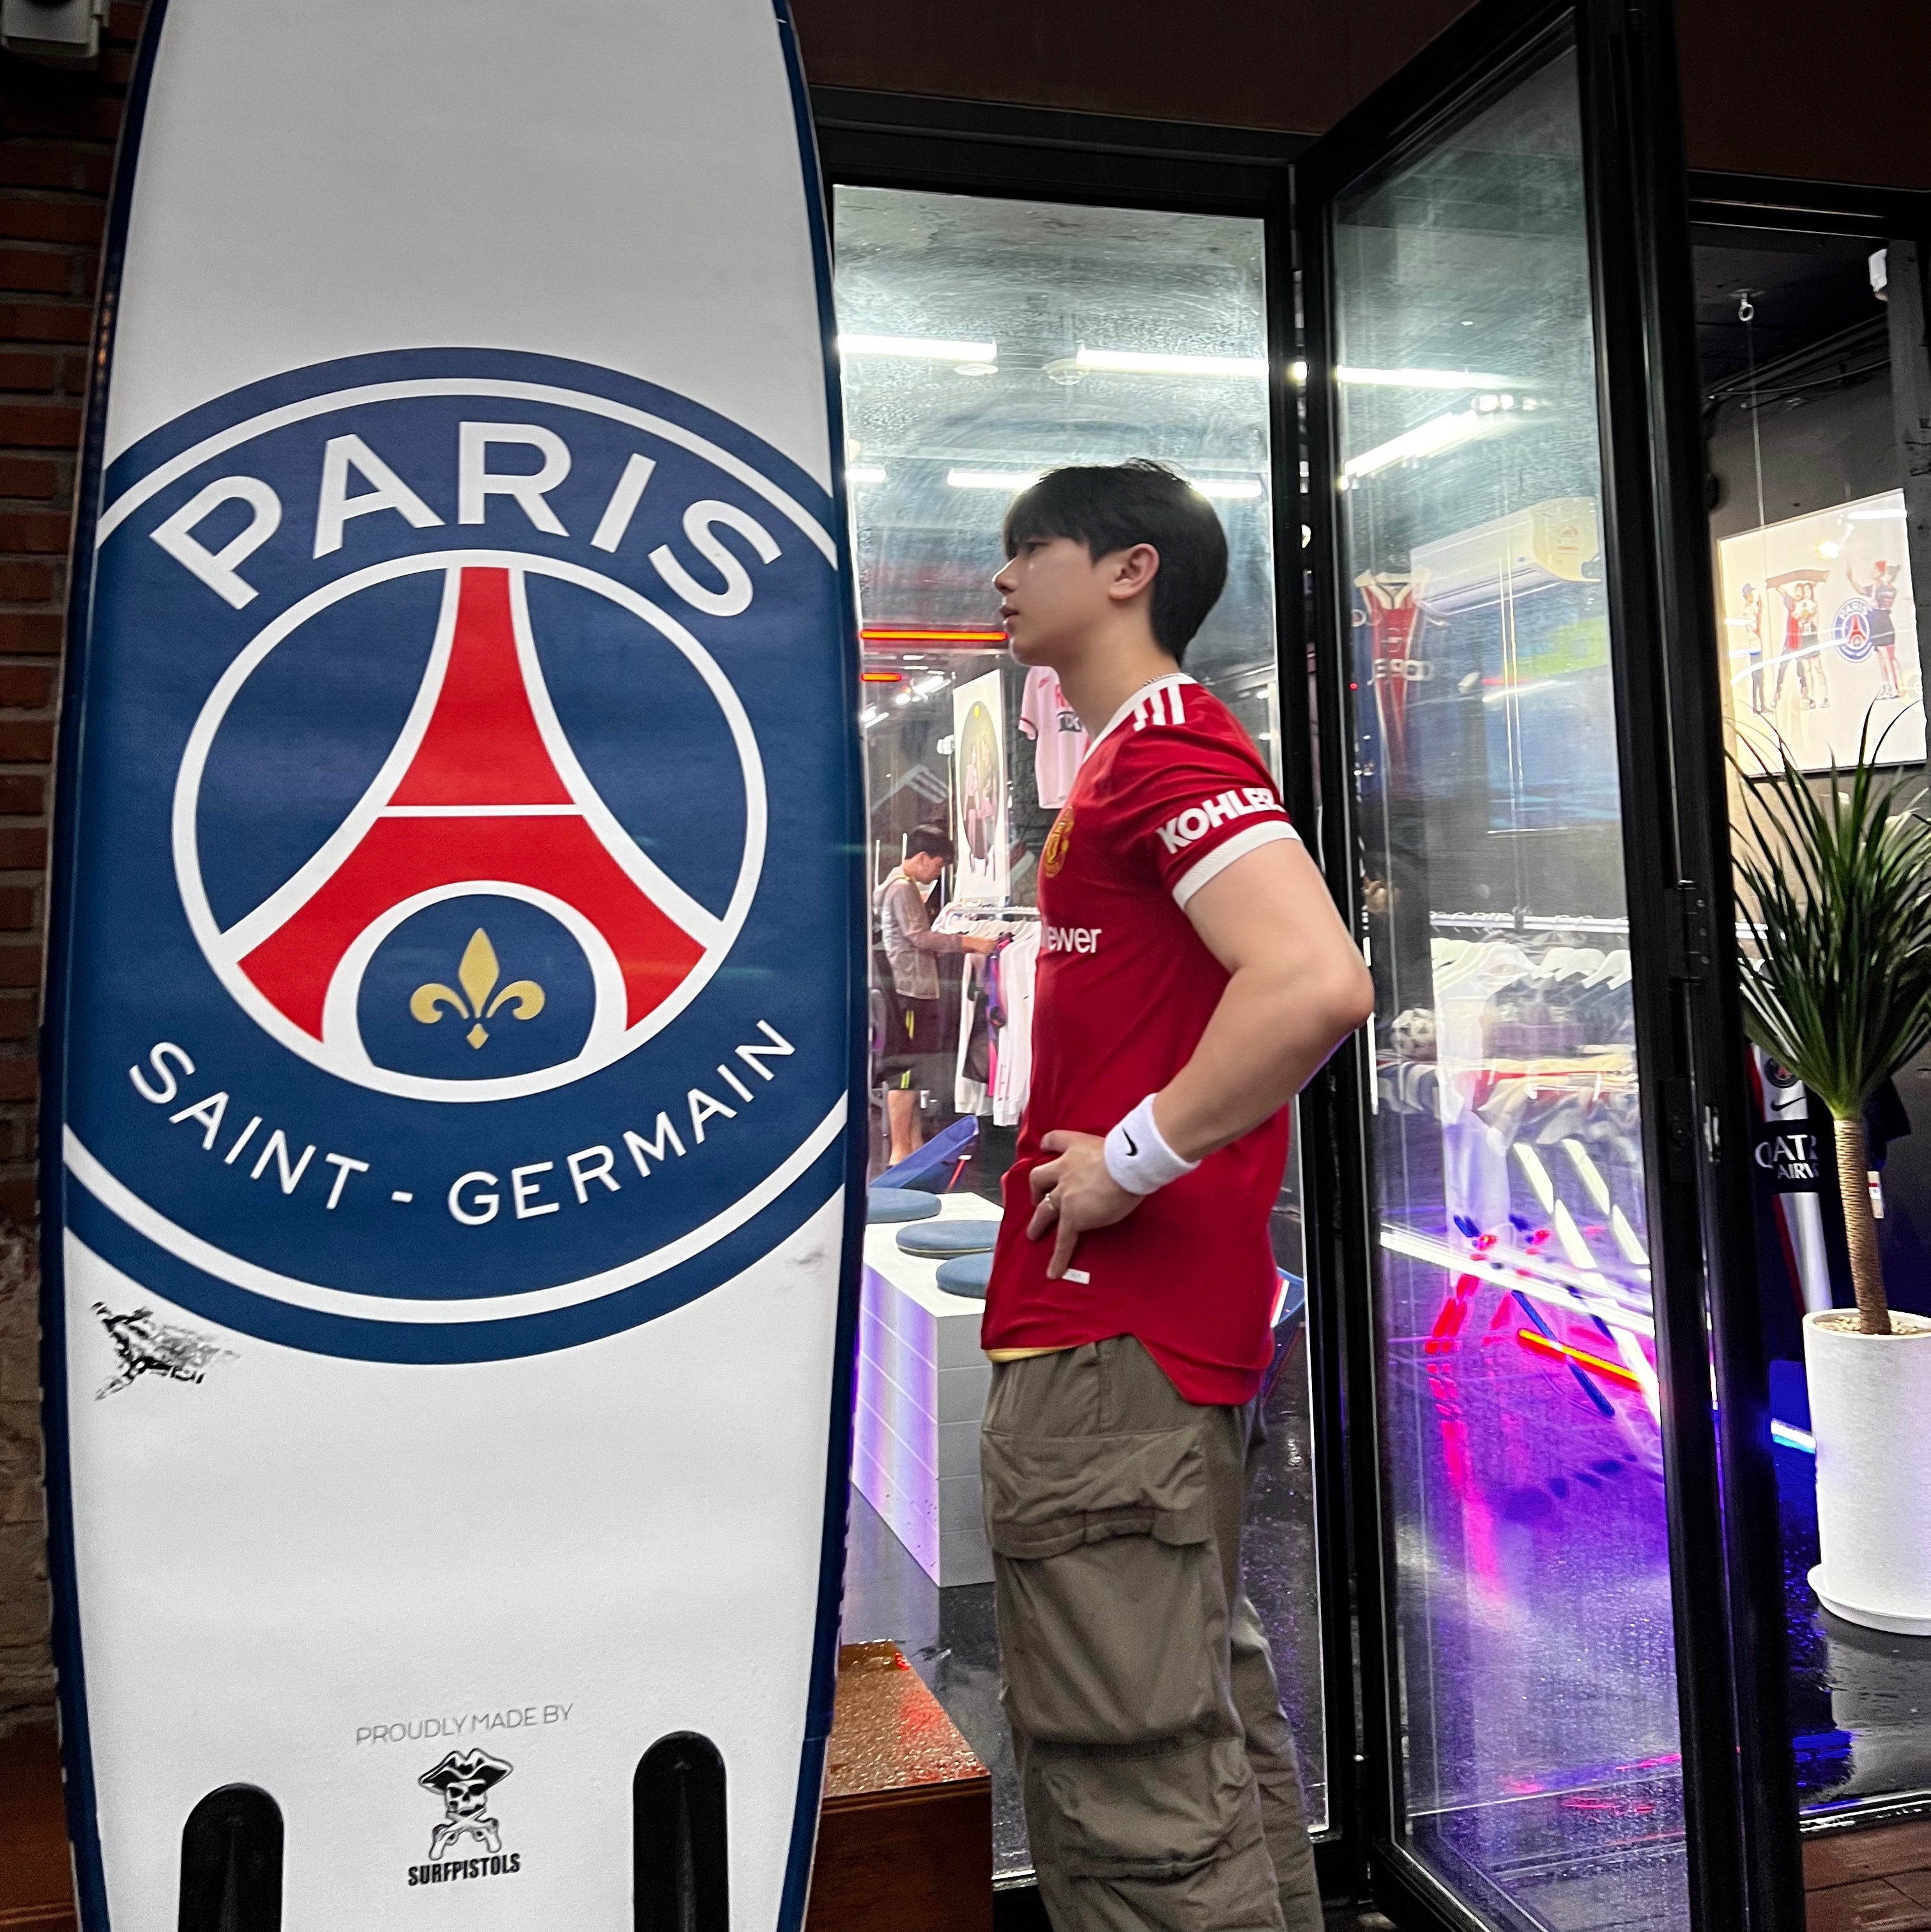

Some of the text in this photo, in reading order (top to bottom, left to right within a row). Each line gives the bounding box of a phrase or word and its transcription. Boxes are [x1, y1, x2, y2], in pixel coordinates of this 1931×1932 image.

[149, 421, 782, 617] PARIS
[1155, 787, 1286, 855] KOHLER
[129, 1042, 370, 1209] SAINT
[448, 1020, 796, 1225] GERMAIN
[356, 1703, 574, 1745] PROUDLY MADE BY
[408, 1853, 521, 1886] SURFPISTOLS
